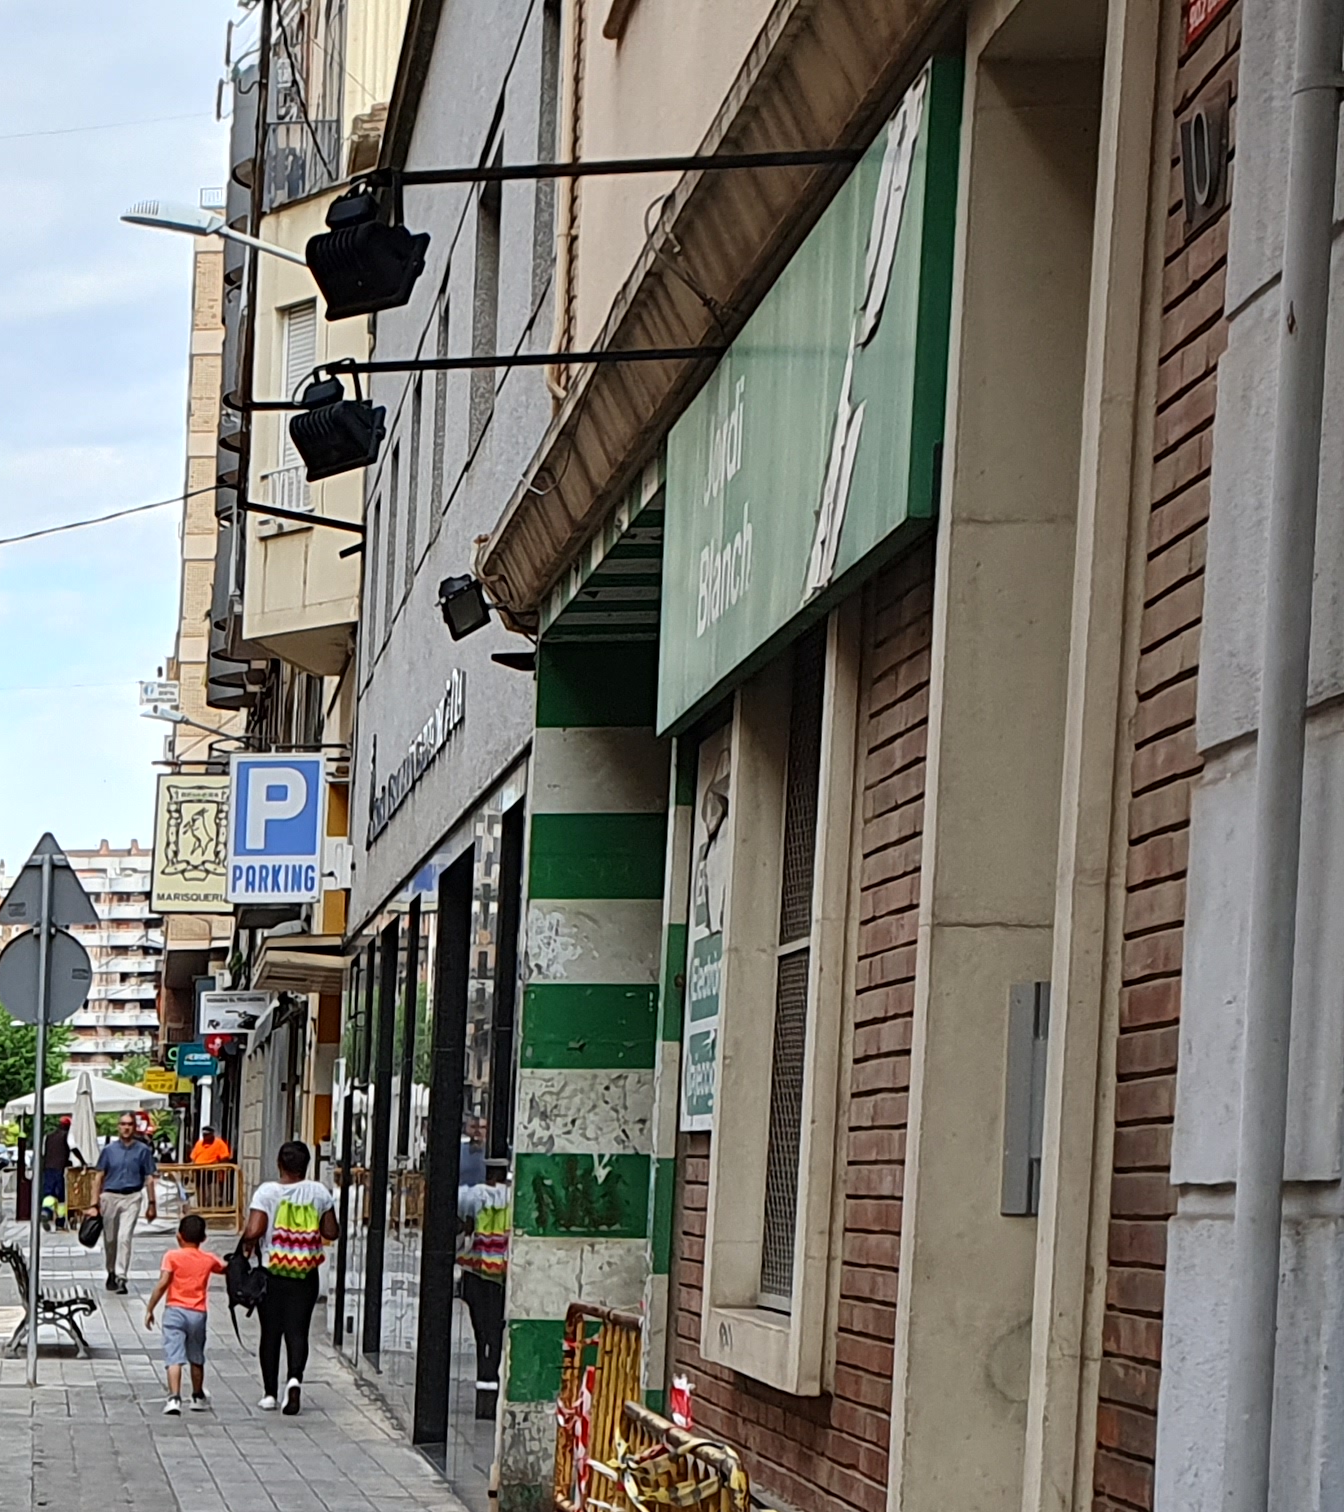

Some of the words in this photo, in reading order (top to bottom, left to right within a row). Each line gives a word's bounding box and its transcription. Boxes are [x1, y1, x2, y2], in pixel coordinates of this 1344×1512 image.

[703, 374, 745, 507] Jordi
[697, 501, 752, 638] Blanch
[244, 766, 308, 851] P
[157, 892, 225, 902] MARISQUERI
[231, 864, 317, 894] PARKING
